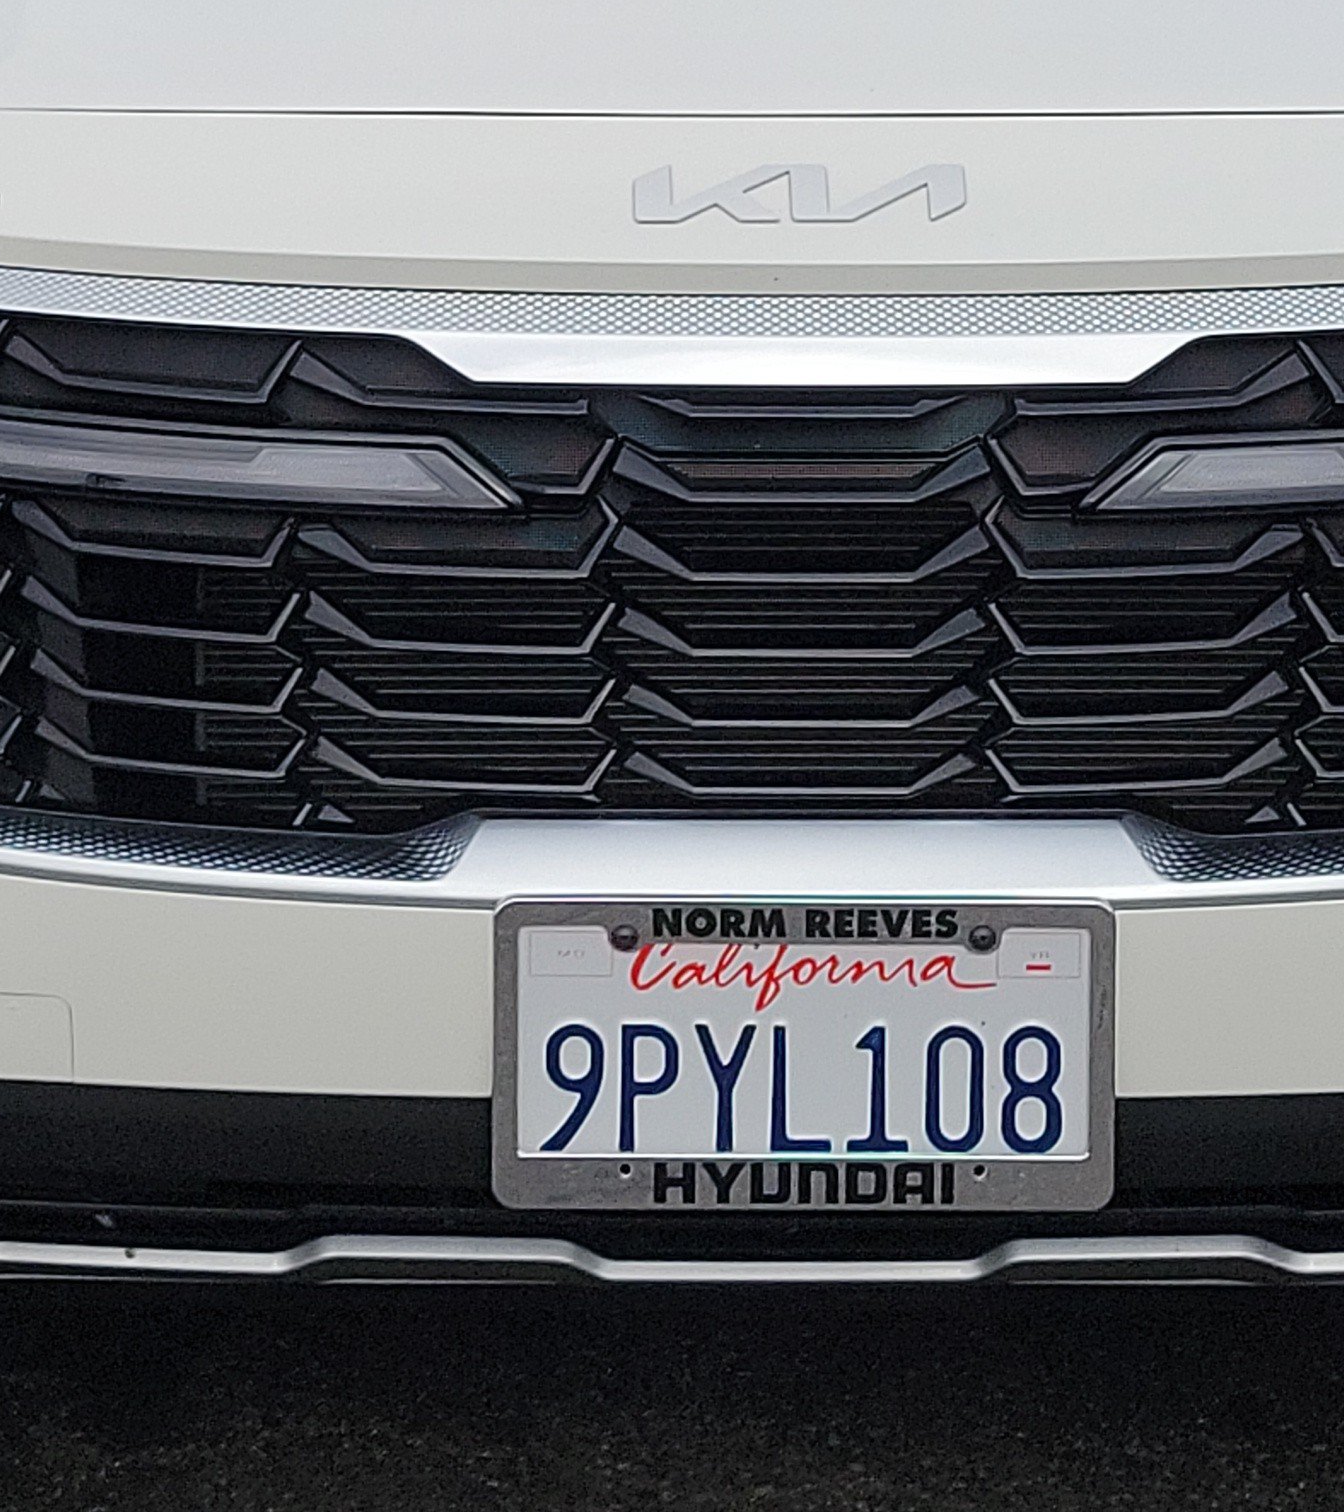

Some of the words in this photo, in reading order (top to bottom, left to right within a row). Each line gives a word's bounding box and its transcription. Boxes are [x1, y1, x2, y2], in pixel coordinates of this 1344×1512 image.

[632, 163, 967, 224] KIA
[652, 908, 786, 939] NORM
[805, 907, 959, 939] REEVES
[629, 943, 997, 1013] California
[539, 1024, 1063, 1153] 9PYL108
[653, 1162, 955, 1205] HYUNDAI
